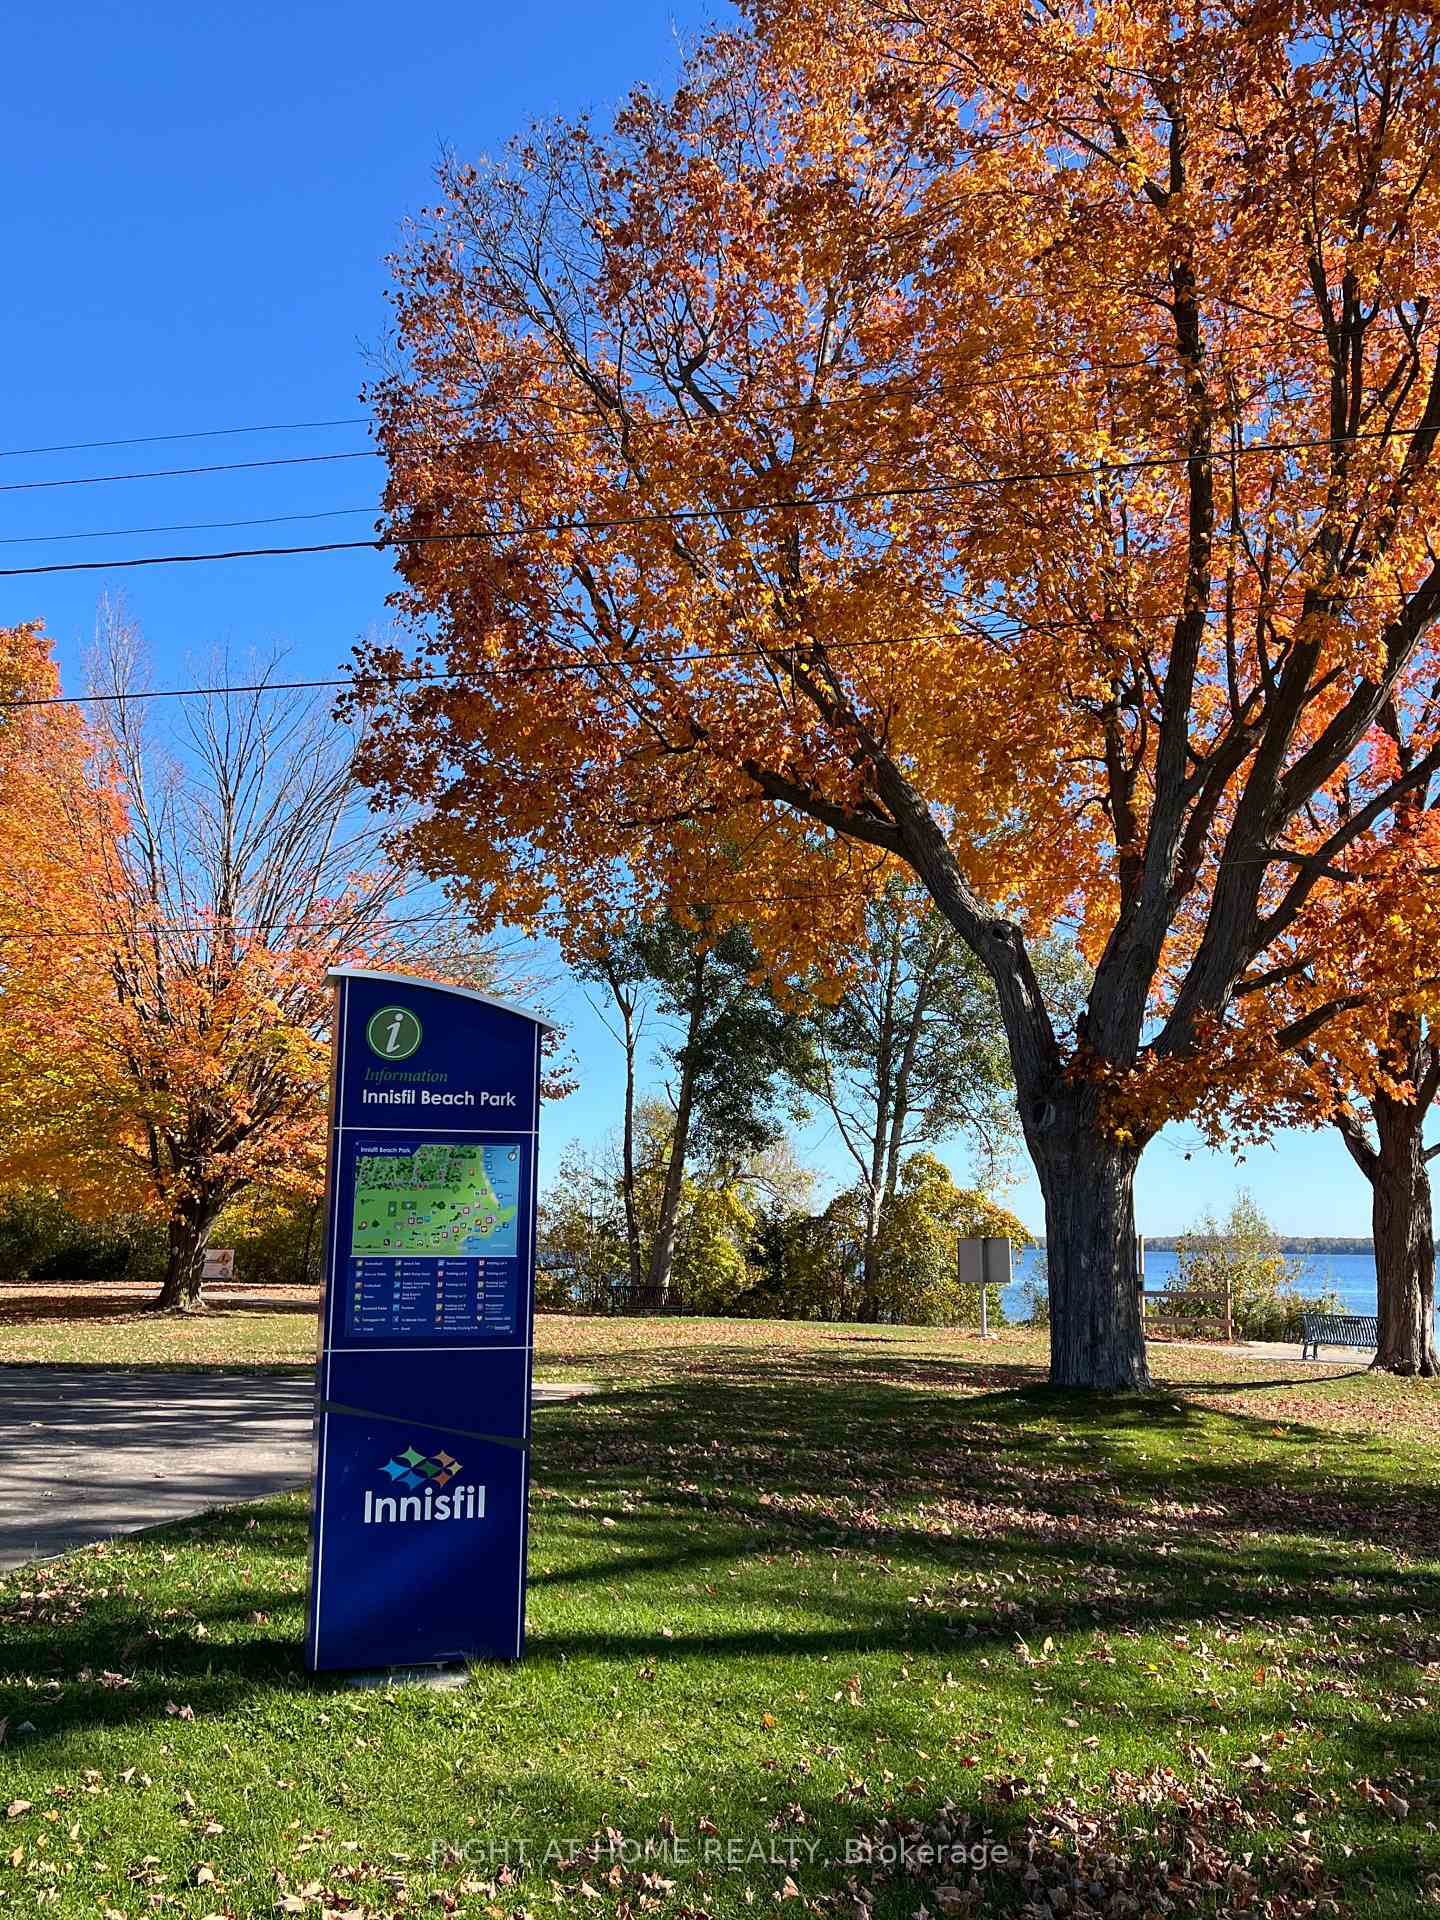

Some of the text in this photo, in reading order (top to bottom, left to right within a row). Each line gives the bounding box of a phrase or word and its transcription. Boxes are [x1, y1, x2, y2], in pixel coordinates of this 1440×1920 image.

[364, 1068, 448, 1085] Information
[362, 1089, 517, 1107] Innisfil Beach Park
[364, 1485, 486, 1523] Innisfil
